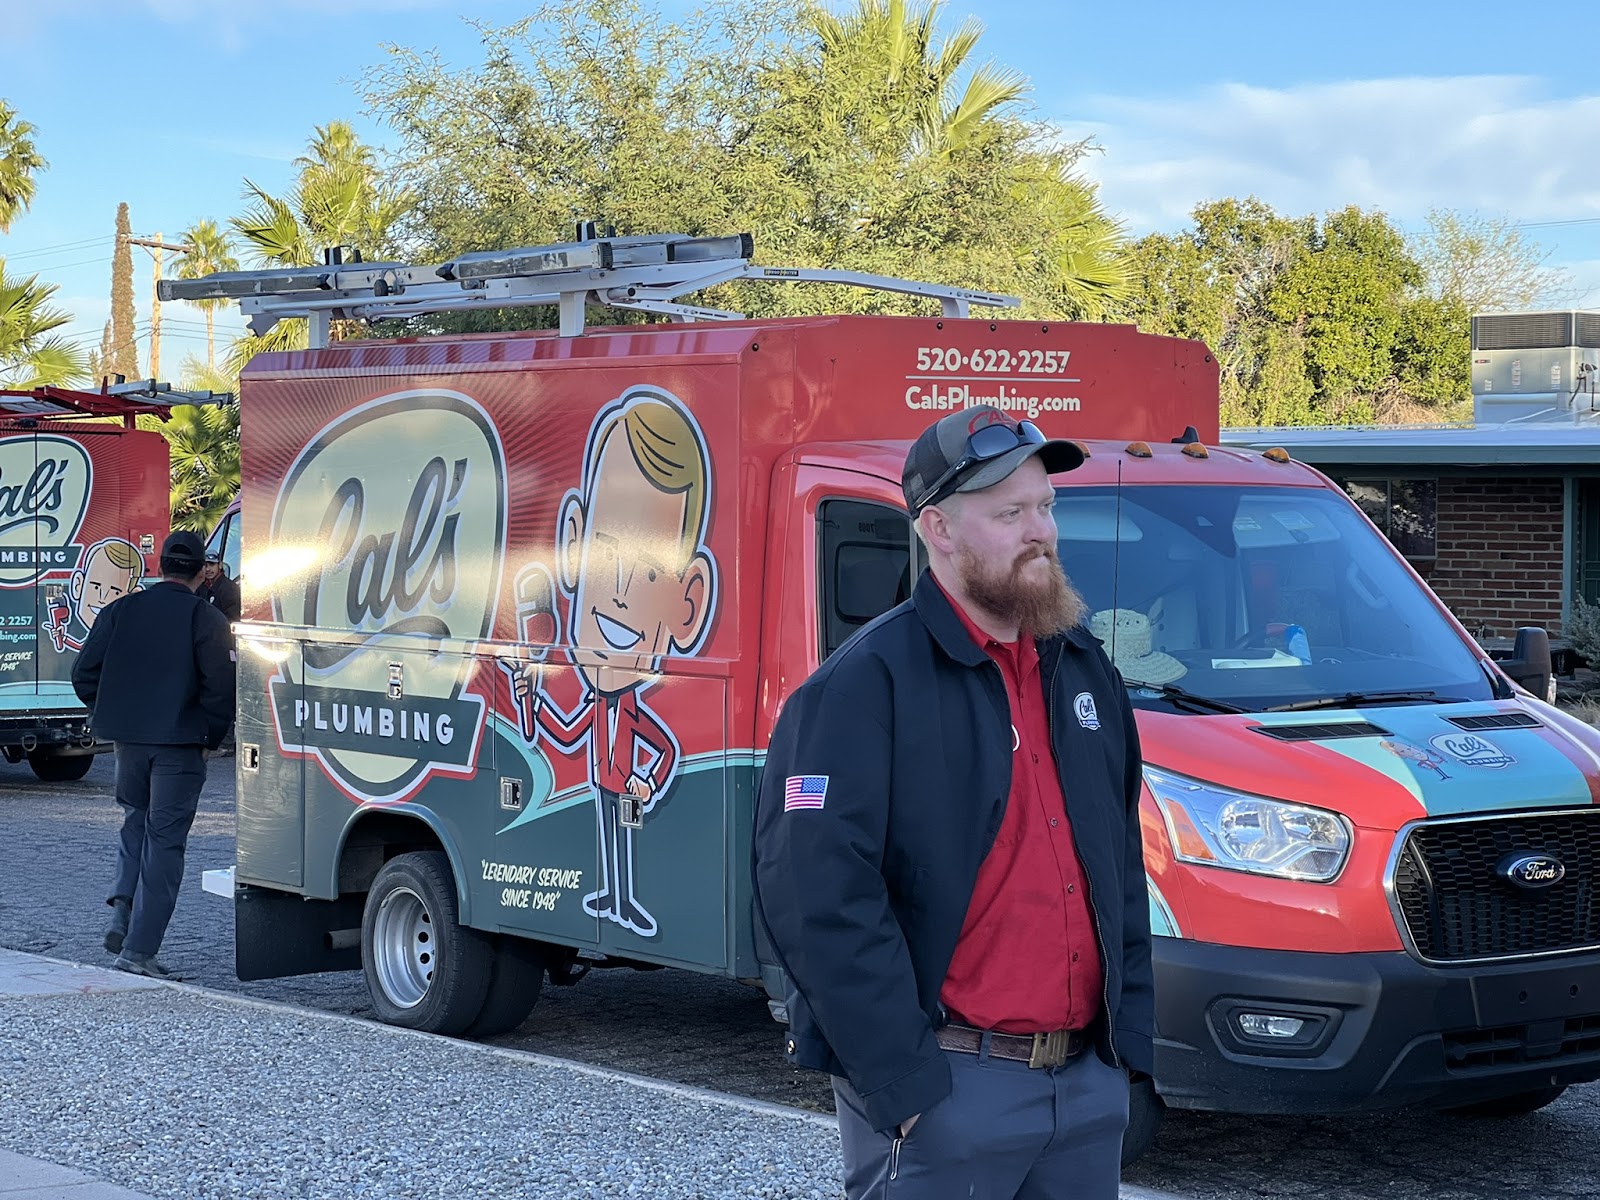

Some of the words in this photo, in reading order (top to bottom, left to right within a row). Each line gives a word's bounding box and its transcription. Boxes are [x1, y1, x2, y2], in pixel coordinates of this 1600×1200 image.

[905, 384, 1081, 419] CalsPlumbing.com
[0, 458, 69, 534] al's
[304, 456, 468, 670] Cal's
[4, 651, 33, 661] SERVICE
[295, 699, 454, 745] PLUMBING
[537, 867, 582, 890] SERVICE
[1525, 861, 1556, 880] Ford
[500, 887, 532, 909] SINCE
